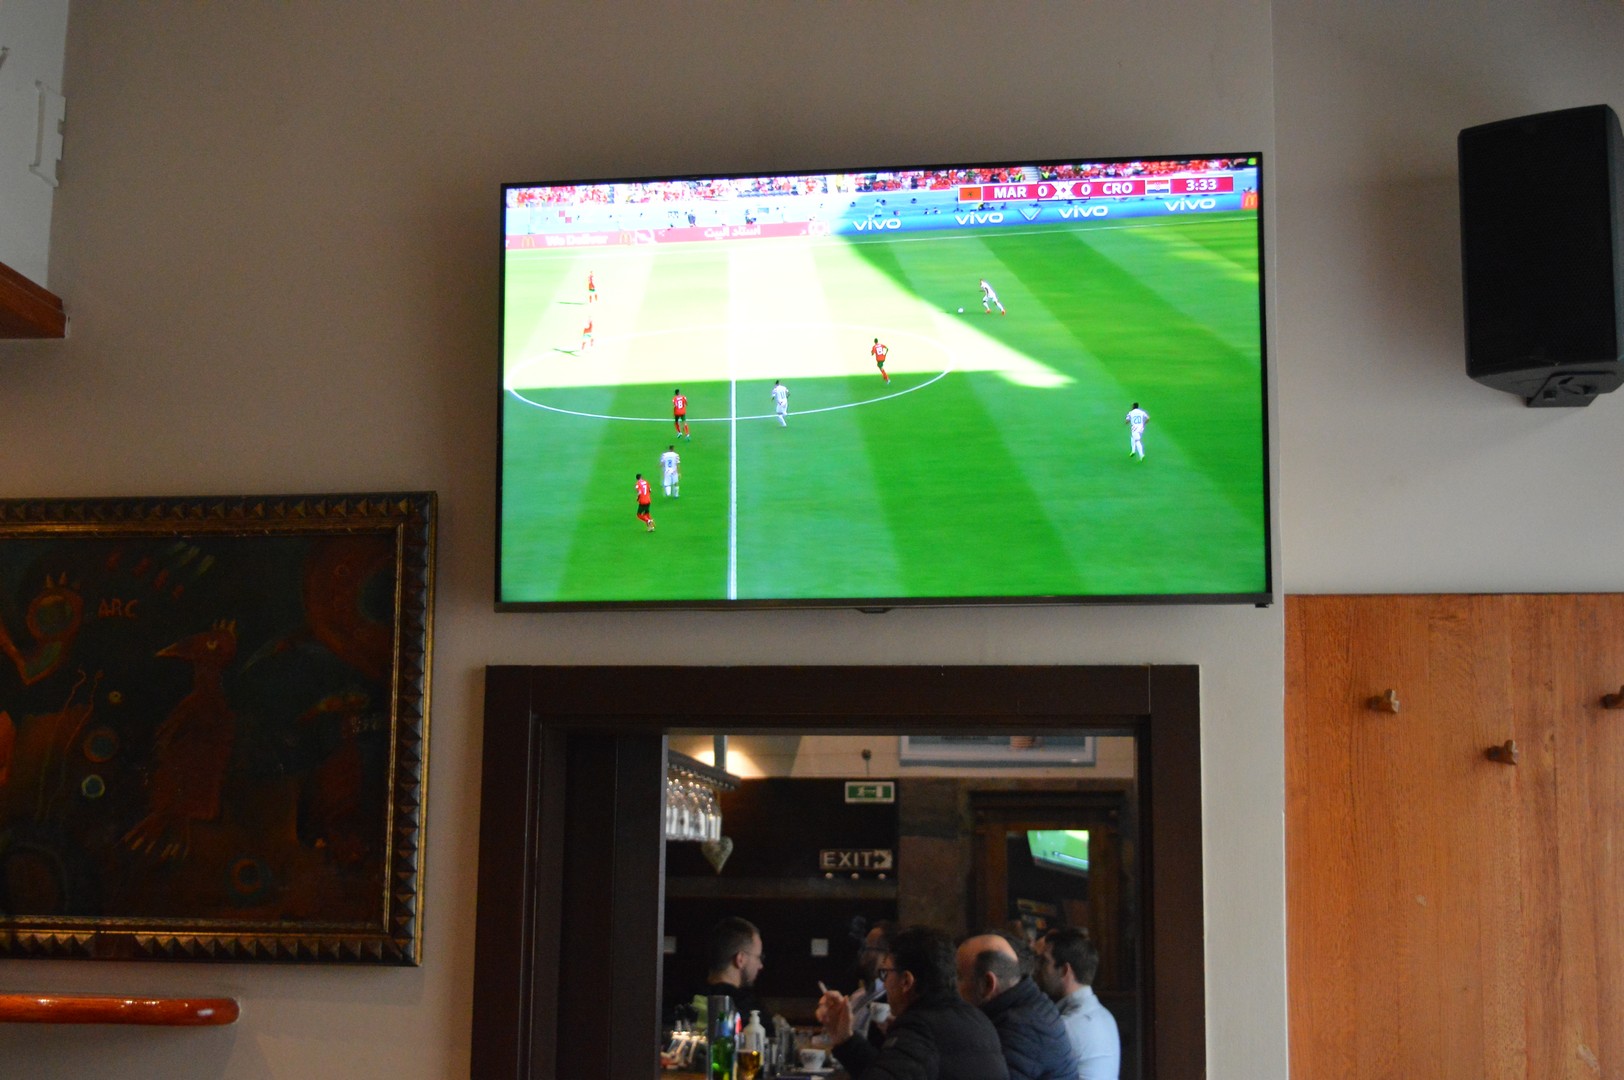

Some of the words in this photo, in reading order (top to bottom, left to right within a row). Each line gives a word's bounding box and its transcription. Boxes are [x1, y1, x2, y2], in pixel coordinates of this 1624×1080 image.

[994, 186, 1027, 199] MAR
[1037, 186, 1048, 197] 0
[1080, 184, 1091, 195] 0
[1102, 182, 1133, 195] CRO
[1186, 179, 1217, 191] 3:33
[1058, 205, 1108, 218] vivo
[1164, 198, 1216, 211] vivo
[853, 216, 902, 231] vivo
[955, 212, 1004, 225] vivo
[823, 851, 873, 867] EXIT
